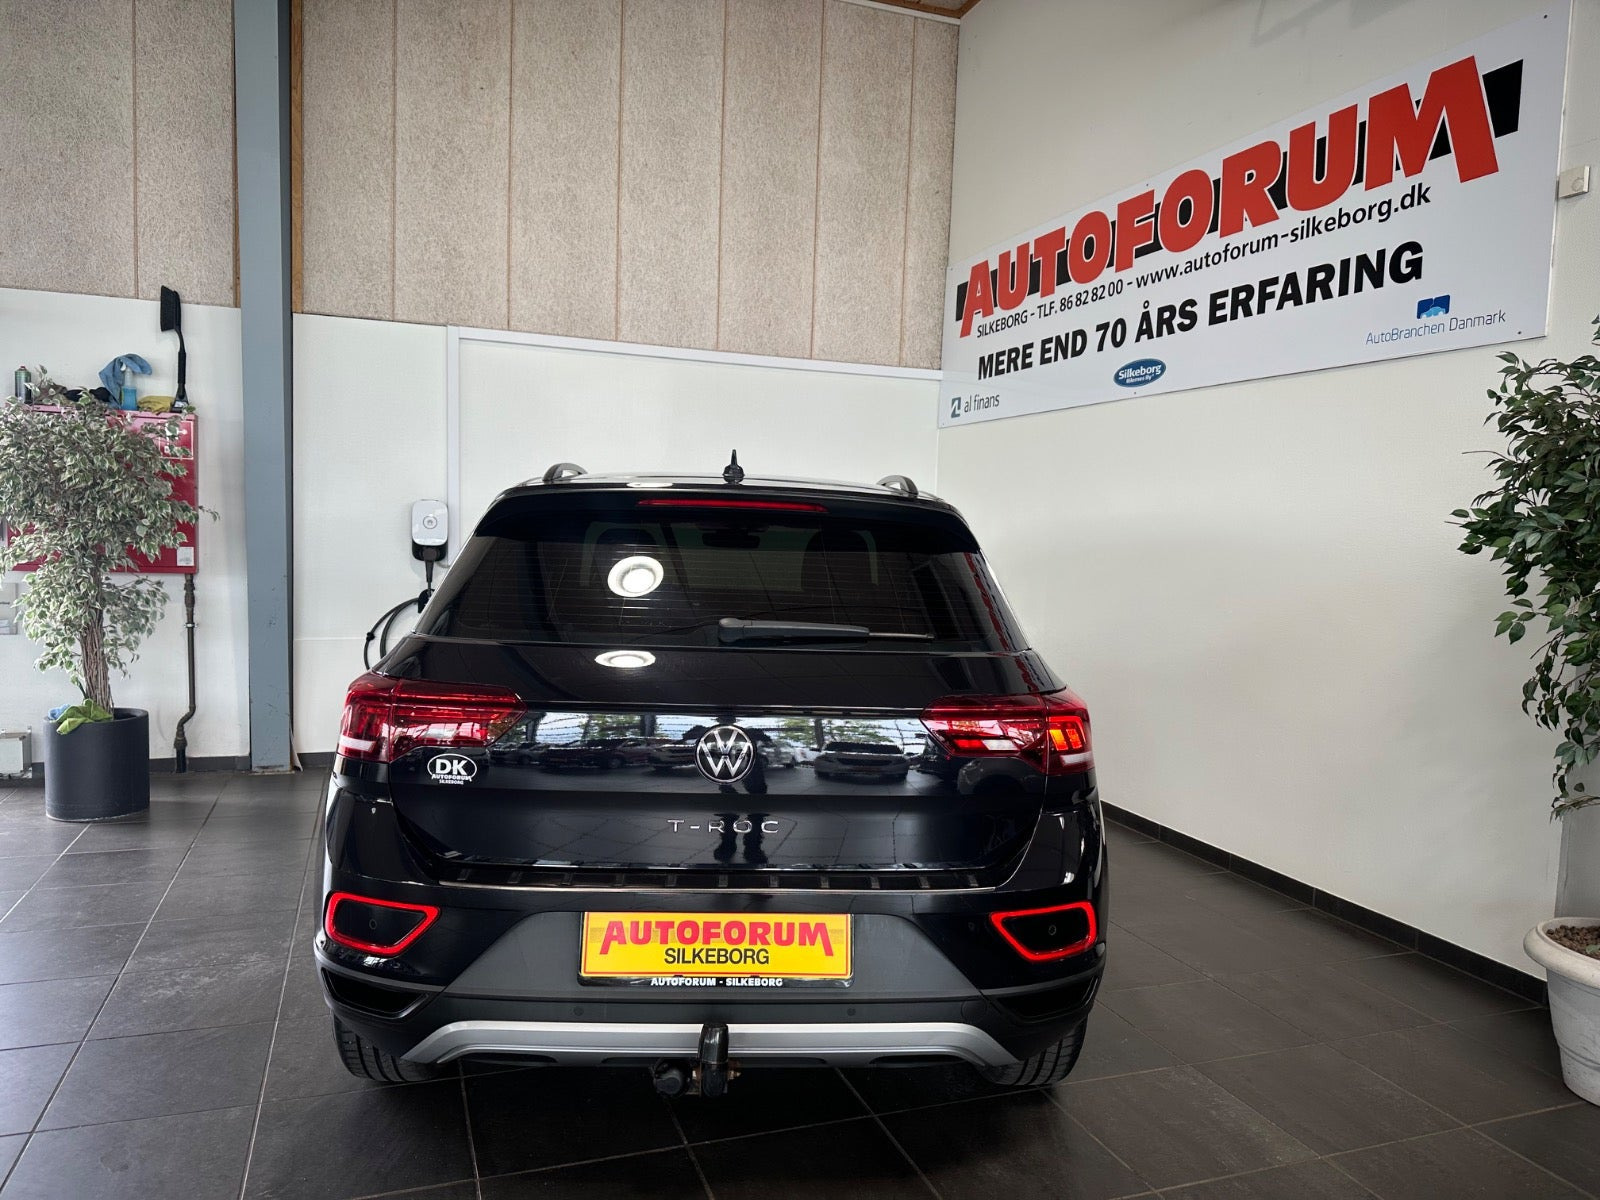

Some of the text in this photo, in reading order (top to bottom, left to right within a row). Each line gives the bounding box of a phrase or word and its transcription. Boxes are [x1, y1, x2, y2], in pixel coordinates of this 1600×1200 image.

[960, 55, 1499, 339] AUTOFORUM
[977, 309, 1028, 338] SILKEBORG
[1037, 301, 1058, 319] TLF.
[1136, 182, 1432, 289] www.autoforum-silkeborg.dk
[978, 240, 1424, 380] MERE END 70 ÅRS ERFARING
[1366, 309, 1507, 345] AutoBranchen Danmark
[1118, 364, 1162, 380] Silkeborg
[963, 393, 1000, 413] al finans
[435, 758, 468, 776] DK
[431, 773, 473, 782] AUTOFORUM
[667, 818, 780, 834] T-ROC
[600, 920, 834, 957] AUTOFORUM
[664, 947, 770, 965] SILKEBORG
[650, 976, 717, 987] AUTOFORUM
[725, 976, 783, 988] SILKEBORG
